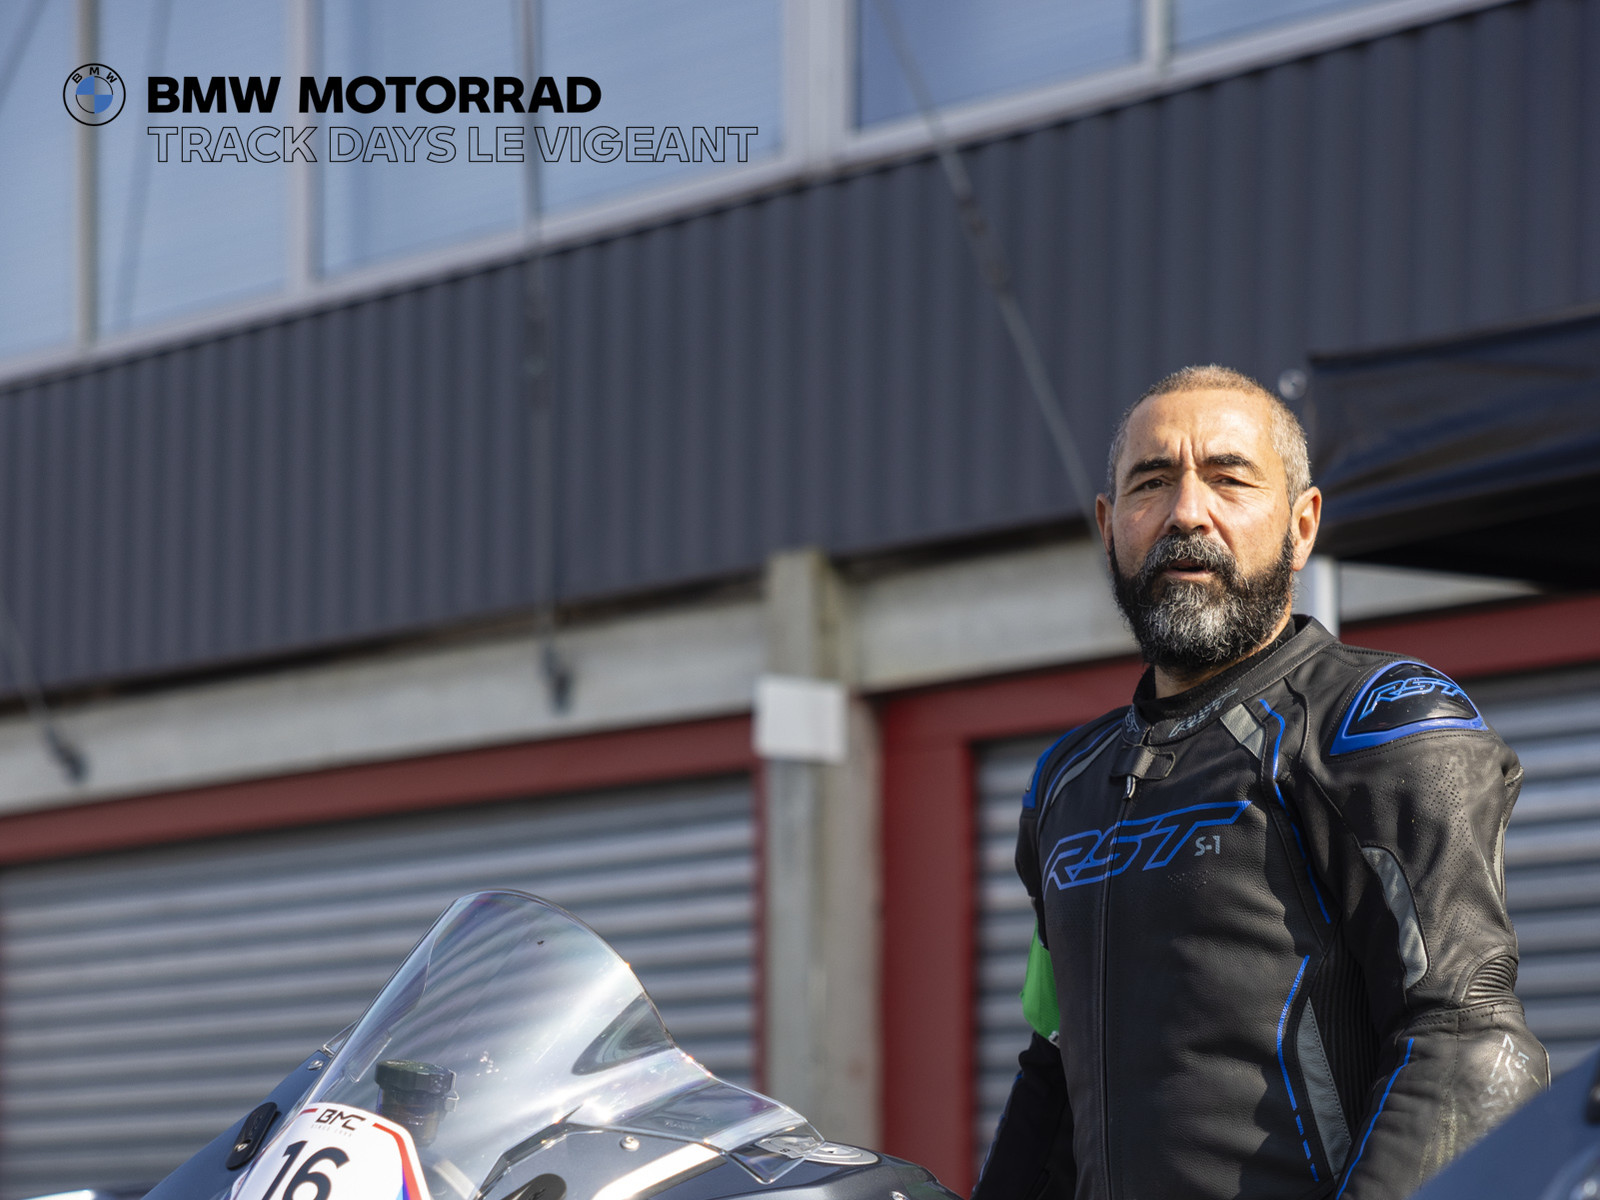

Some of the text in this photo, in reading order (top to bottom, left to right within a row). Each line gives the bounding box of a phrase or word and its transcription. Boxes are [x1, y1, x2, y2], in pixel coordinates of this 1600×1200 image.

[1357, 677, 1467, 722] RST
[1042, 800, 1252, 898] RST S-1
